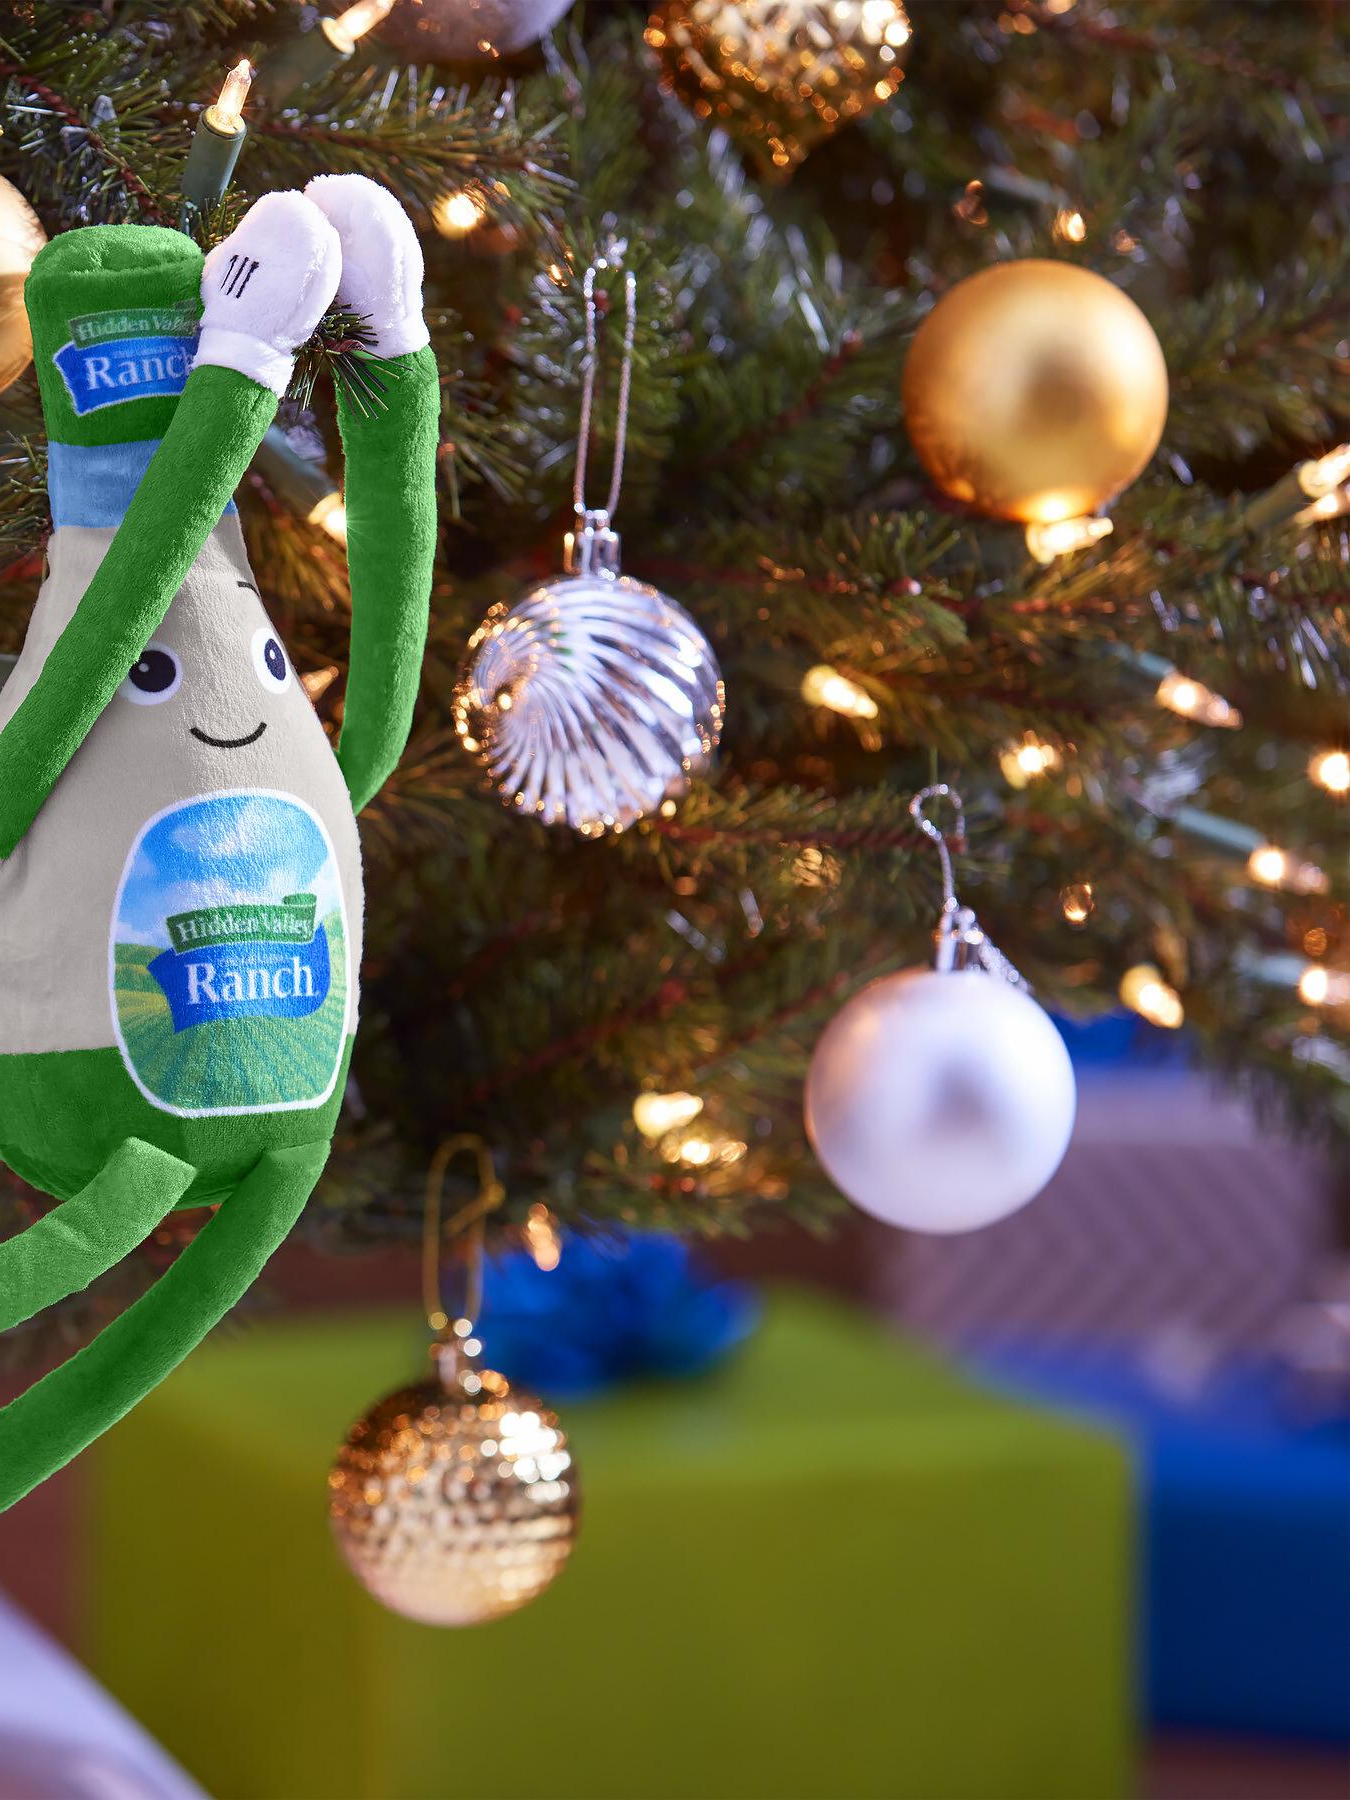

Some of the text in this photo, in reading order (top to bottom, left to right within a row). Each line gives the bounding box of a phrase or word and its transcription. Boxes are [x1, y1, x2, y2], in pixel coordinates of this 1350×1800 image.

[76, 316, 149, 340] Hidden
[176, 912, 311, 942] Hidden Valley
[183, 957, 318, 1006] Ranch
